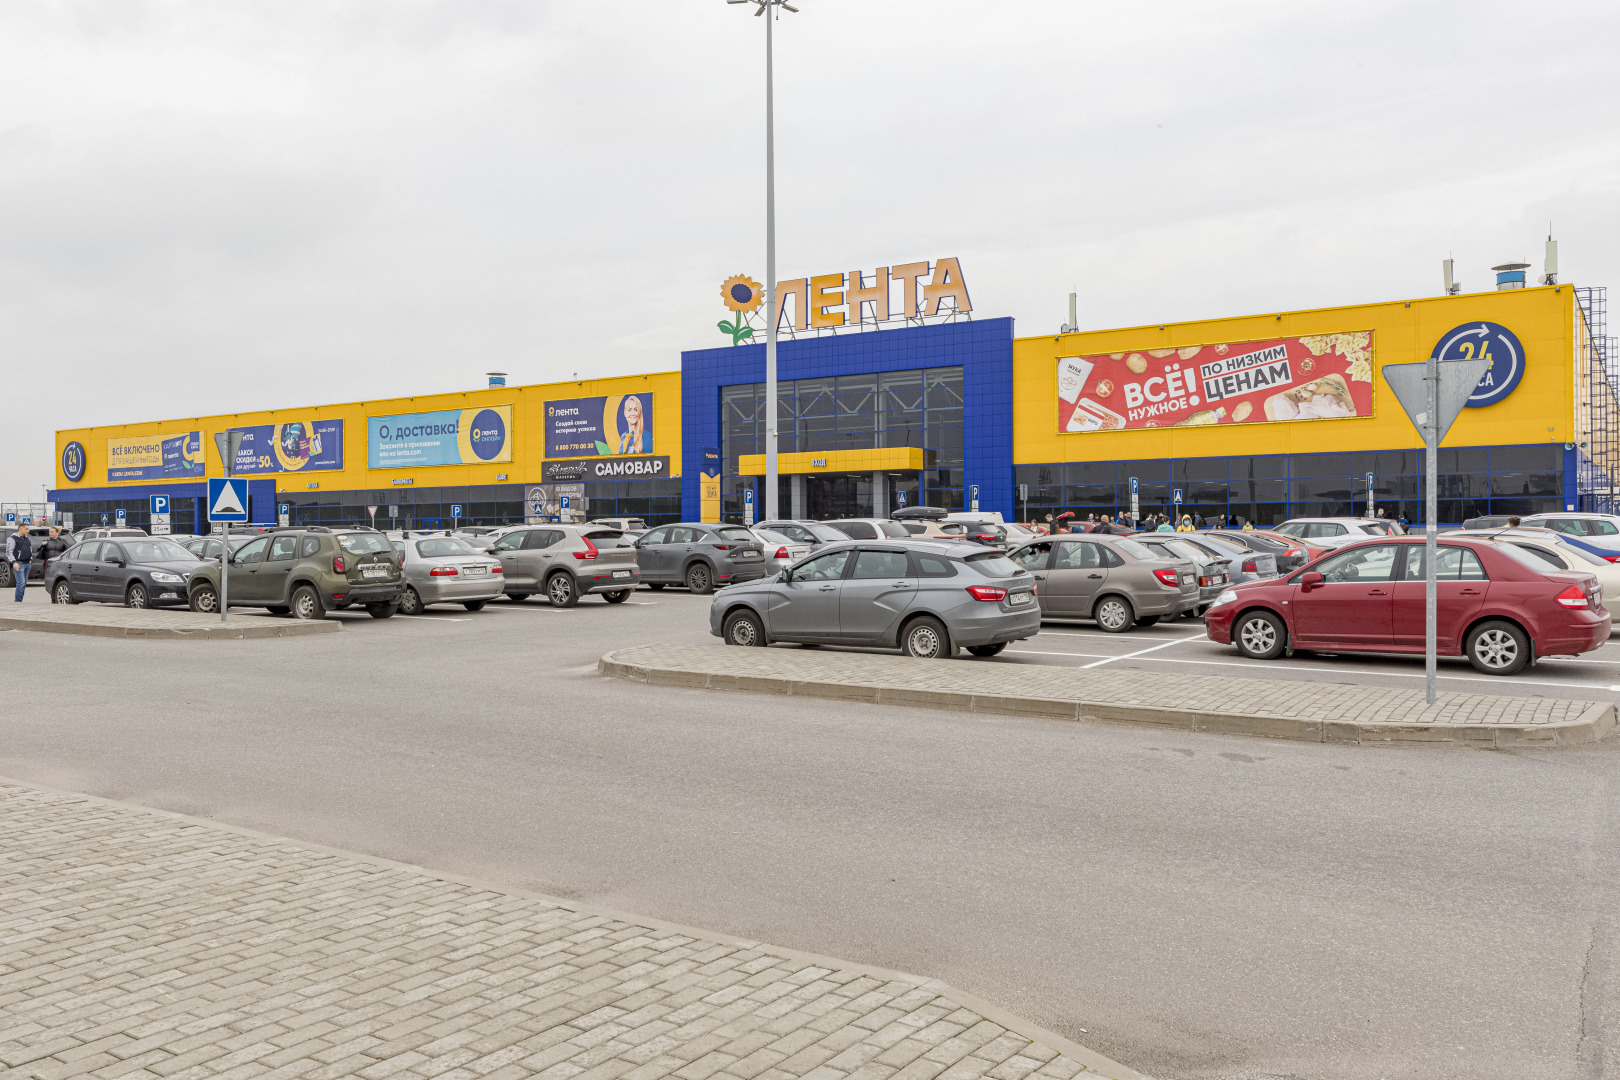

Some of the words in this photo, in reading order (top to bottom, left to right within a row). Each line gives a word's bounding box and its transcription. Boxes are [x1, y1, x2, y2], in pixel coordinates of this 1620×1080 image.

[768, 257, 973, 332] ЛЕНТА
[1202, 363, 1222, 377] ПО
[1226, 346, 1286, 372] НИЗКИМ
[1205, 362, 1290, 400] ЦЕНАМ
[555, 408, 579, 416] лента
[1128, 397, 1188, 421] НУЖНОЕ
[380, 424, 392, 440] О,
[396, 419, 460, 440] доставка!
[69, 451, 76, 464] 24
[112, 444, 123, 455] ВСЁ
[124, 444, 160, 455] ВКЛЮЧЕНО
[595, 460, 663, 476] САМОВАР
[811, 458, 826, 467] ВХОД
[156, 498, 166, 512] P
